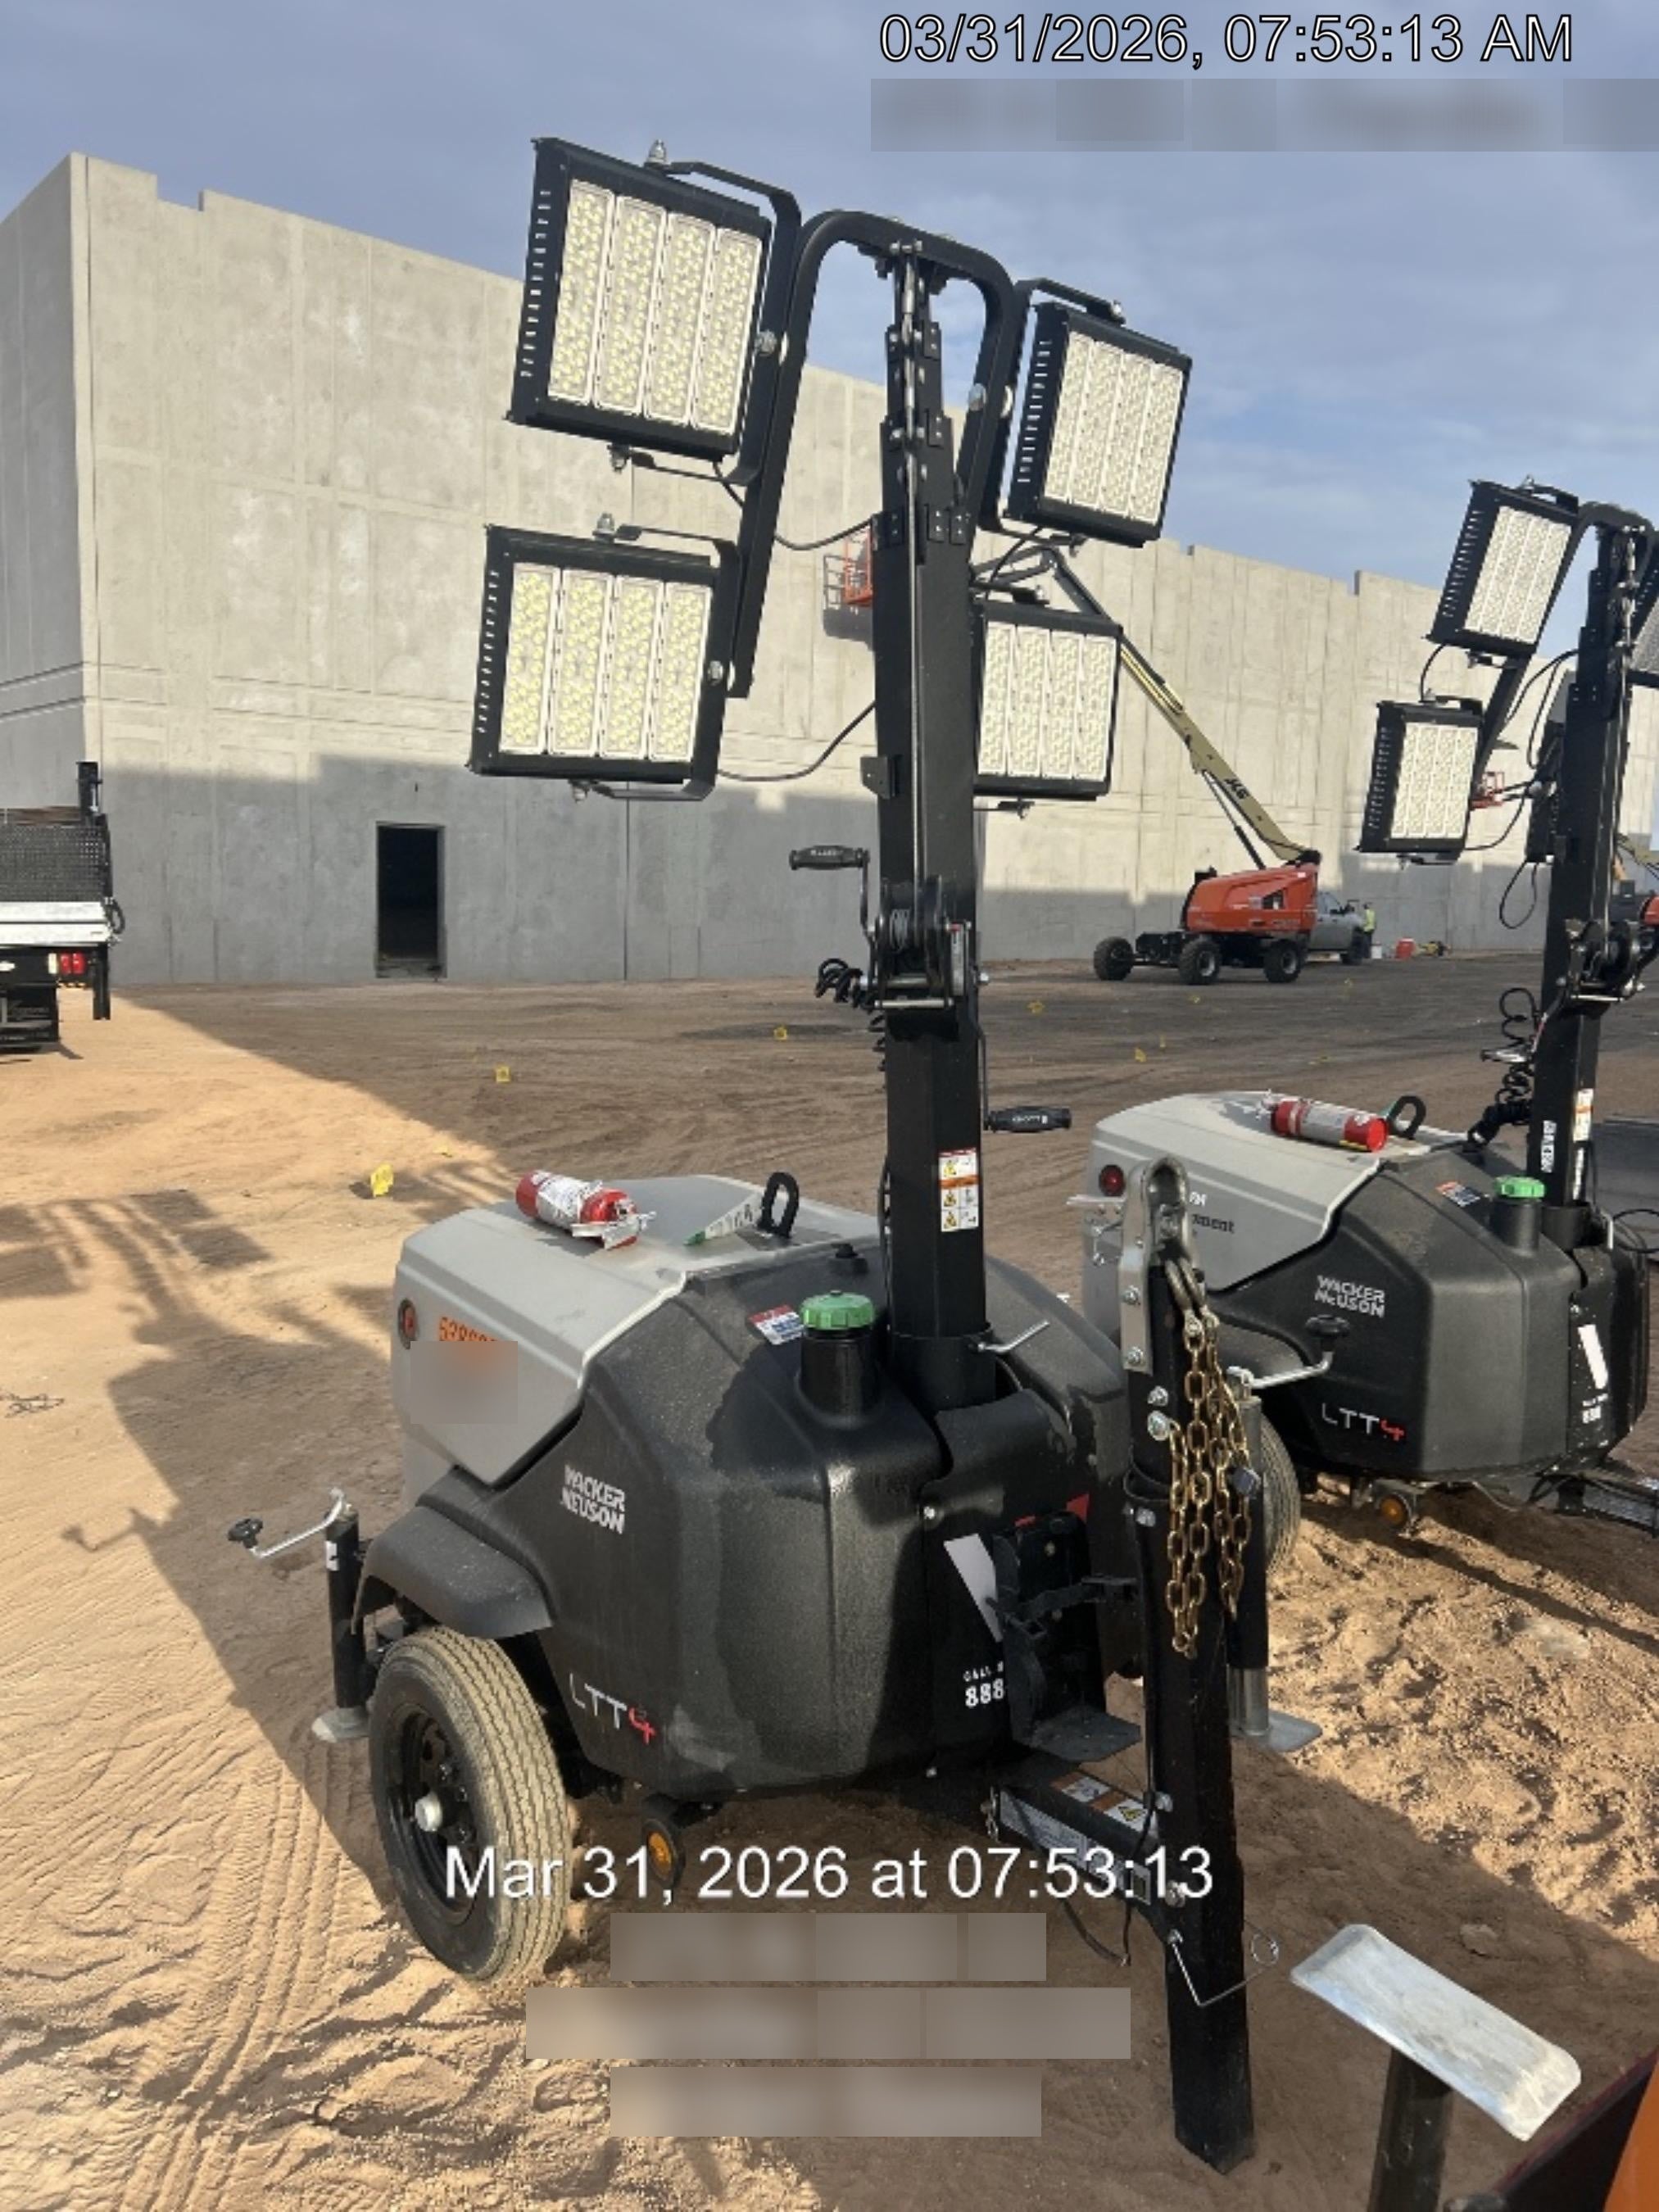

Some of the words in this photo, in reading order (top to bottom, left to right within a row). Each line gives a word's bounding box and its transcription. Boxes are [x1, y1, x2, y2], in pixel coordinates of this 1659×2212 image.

[1314, 1288, 1385, 1318] NEUSON
[1317, 1274, 1385, 1303] WACKER
[1321, 1402, 1404, 1441] LTT4
[564, 1463, 625, 1512] WACKER
[561, 1485, 625, 1535] NEUSON
[569, 1672, 656, 1745] LTT4
